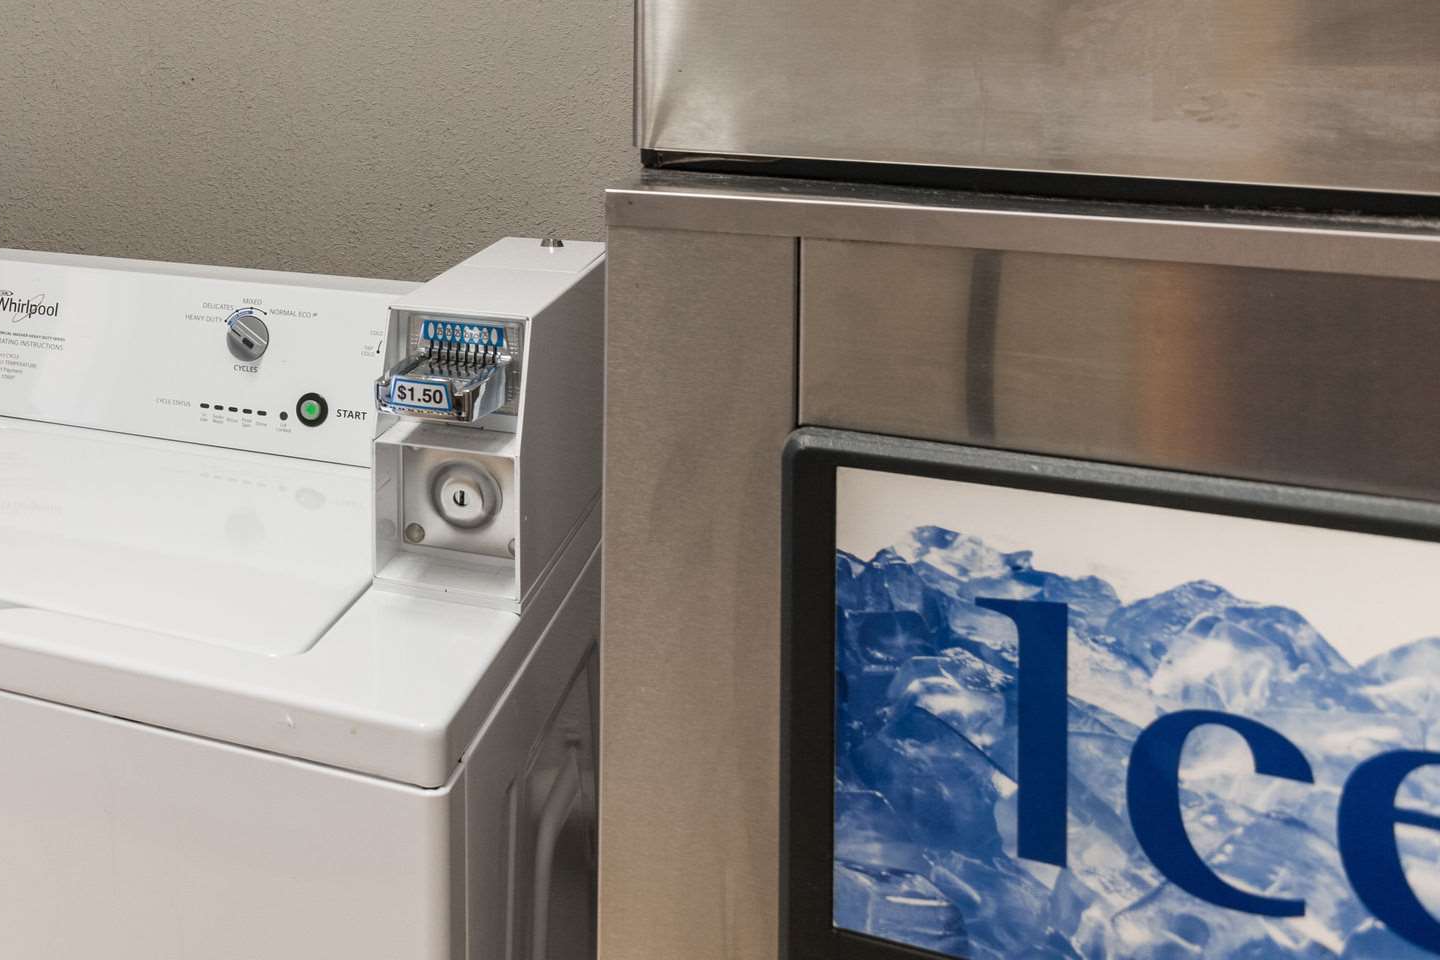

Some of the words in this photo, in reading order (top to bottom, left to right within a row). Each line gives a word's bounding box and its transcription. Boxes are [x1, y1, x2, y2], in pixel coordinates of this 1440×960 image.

[202, 302, 234, 311] DELICATES
[269, 308, 297, 318] NORMAL
[298, 311, 312, 319] ECO
[206, 315, 223, 323] DUTY
[20, 340, 64, 350] INSTRUCTIONS
[233, 364, 258, 373] CYCLES
[397, 385, 443, 404] $1.50
[336, 408, 368, 421] START
